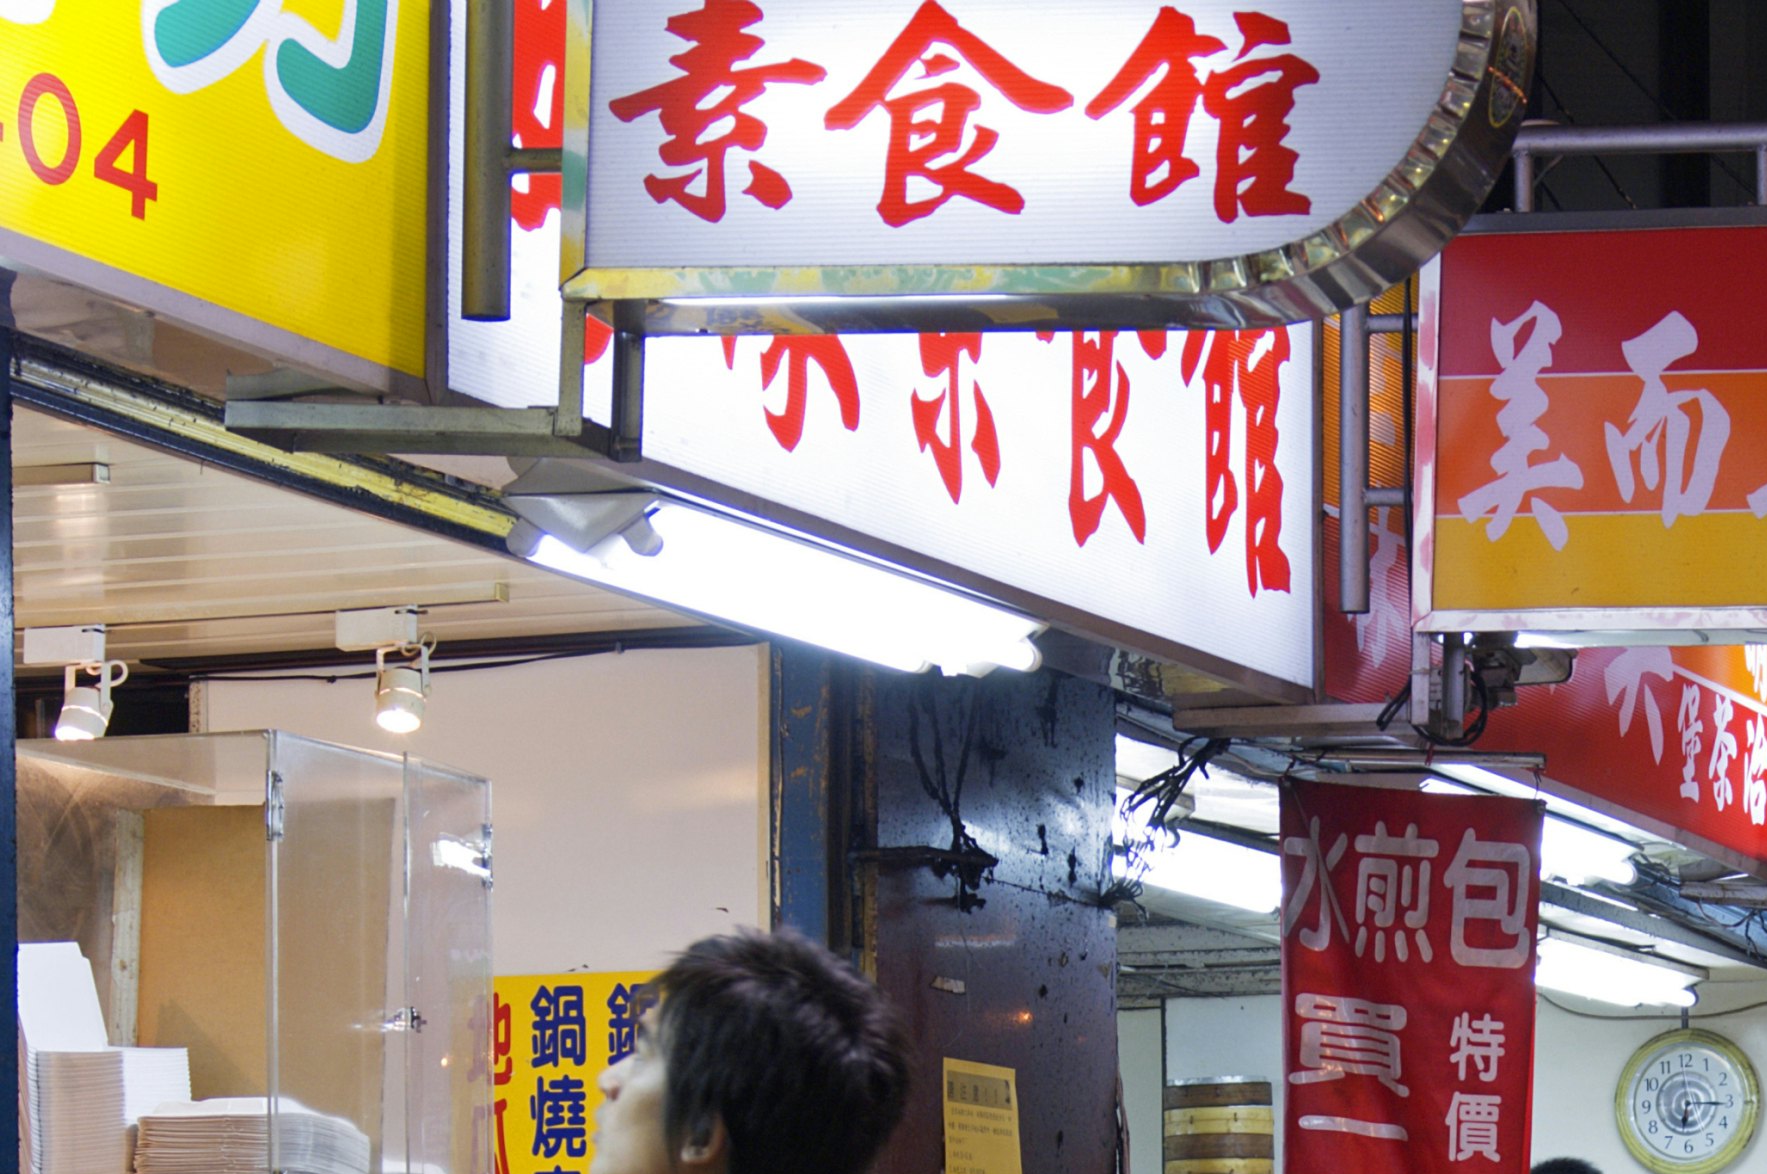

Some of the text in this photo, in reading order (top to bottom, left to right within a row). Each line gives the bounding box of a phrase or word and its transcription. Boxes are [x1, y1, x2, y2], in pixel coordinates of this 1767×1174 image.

[609, 0, 1320, 227] 素食館
[1283, 814, 1532, 968] 水煎包
[1445, 1011, 1507, 1164] 特價
[1678, 1053, 1693, 1068] 12
